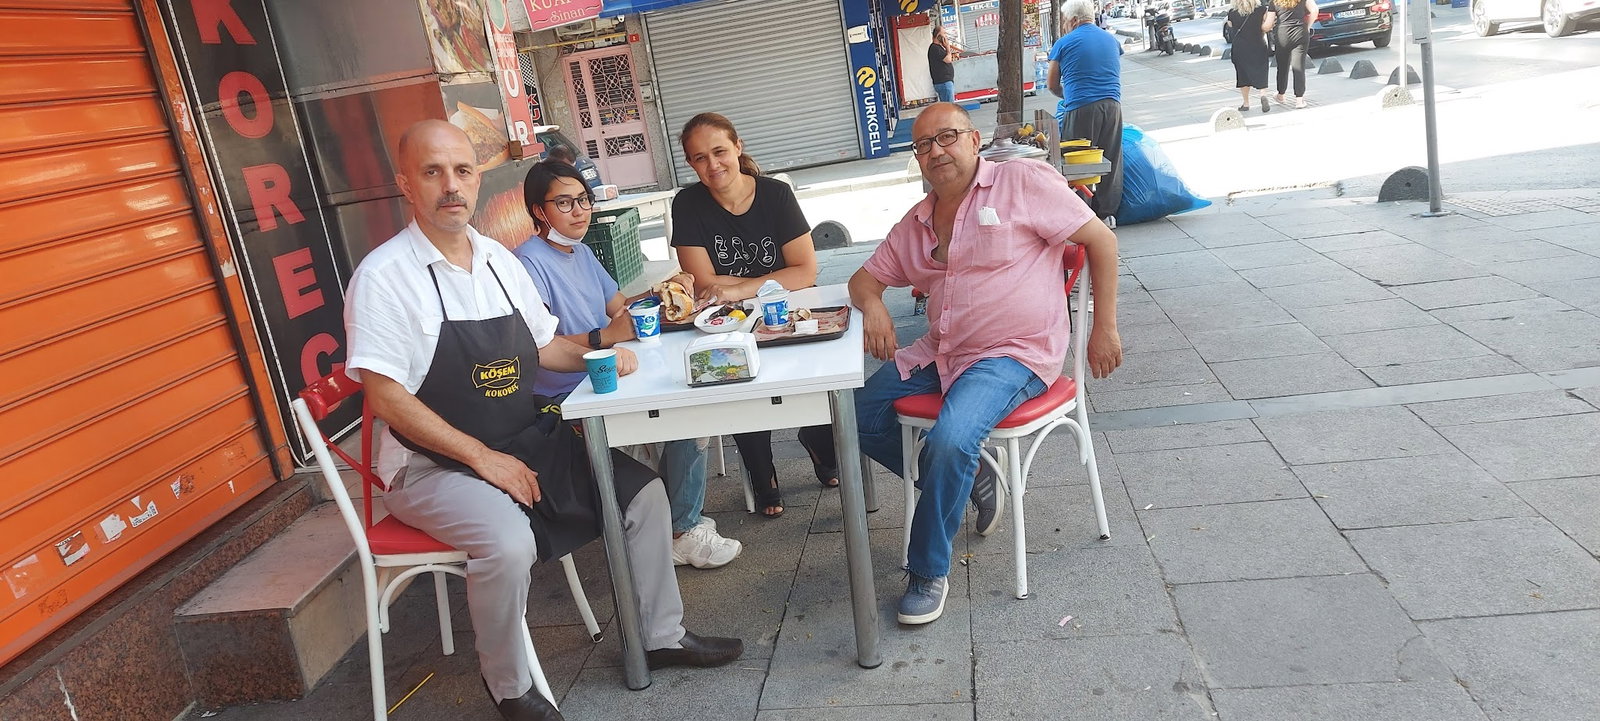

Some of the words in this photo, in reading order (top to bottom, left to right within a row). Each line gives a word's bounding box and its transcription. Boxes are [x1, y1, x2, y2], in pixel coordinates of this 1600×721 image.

[550, 8, 585, 22] Sinan
[863, 87, 881, 155] TURKCELL
[480, 365, 516, 379] KÖŞEM
[485, 381, 520, 397] KOKOREÇ
